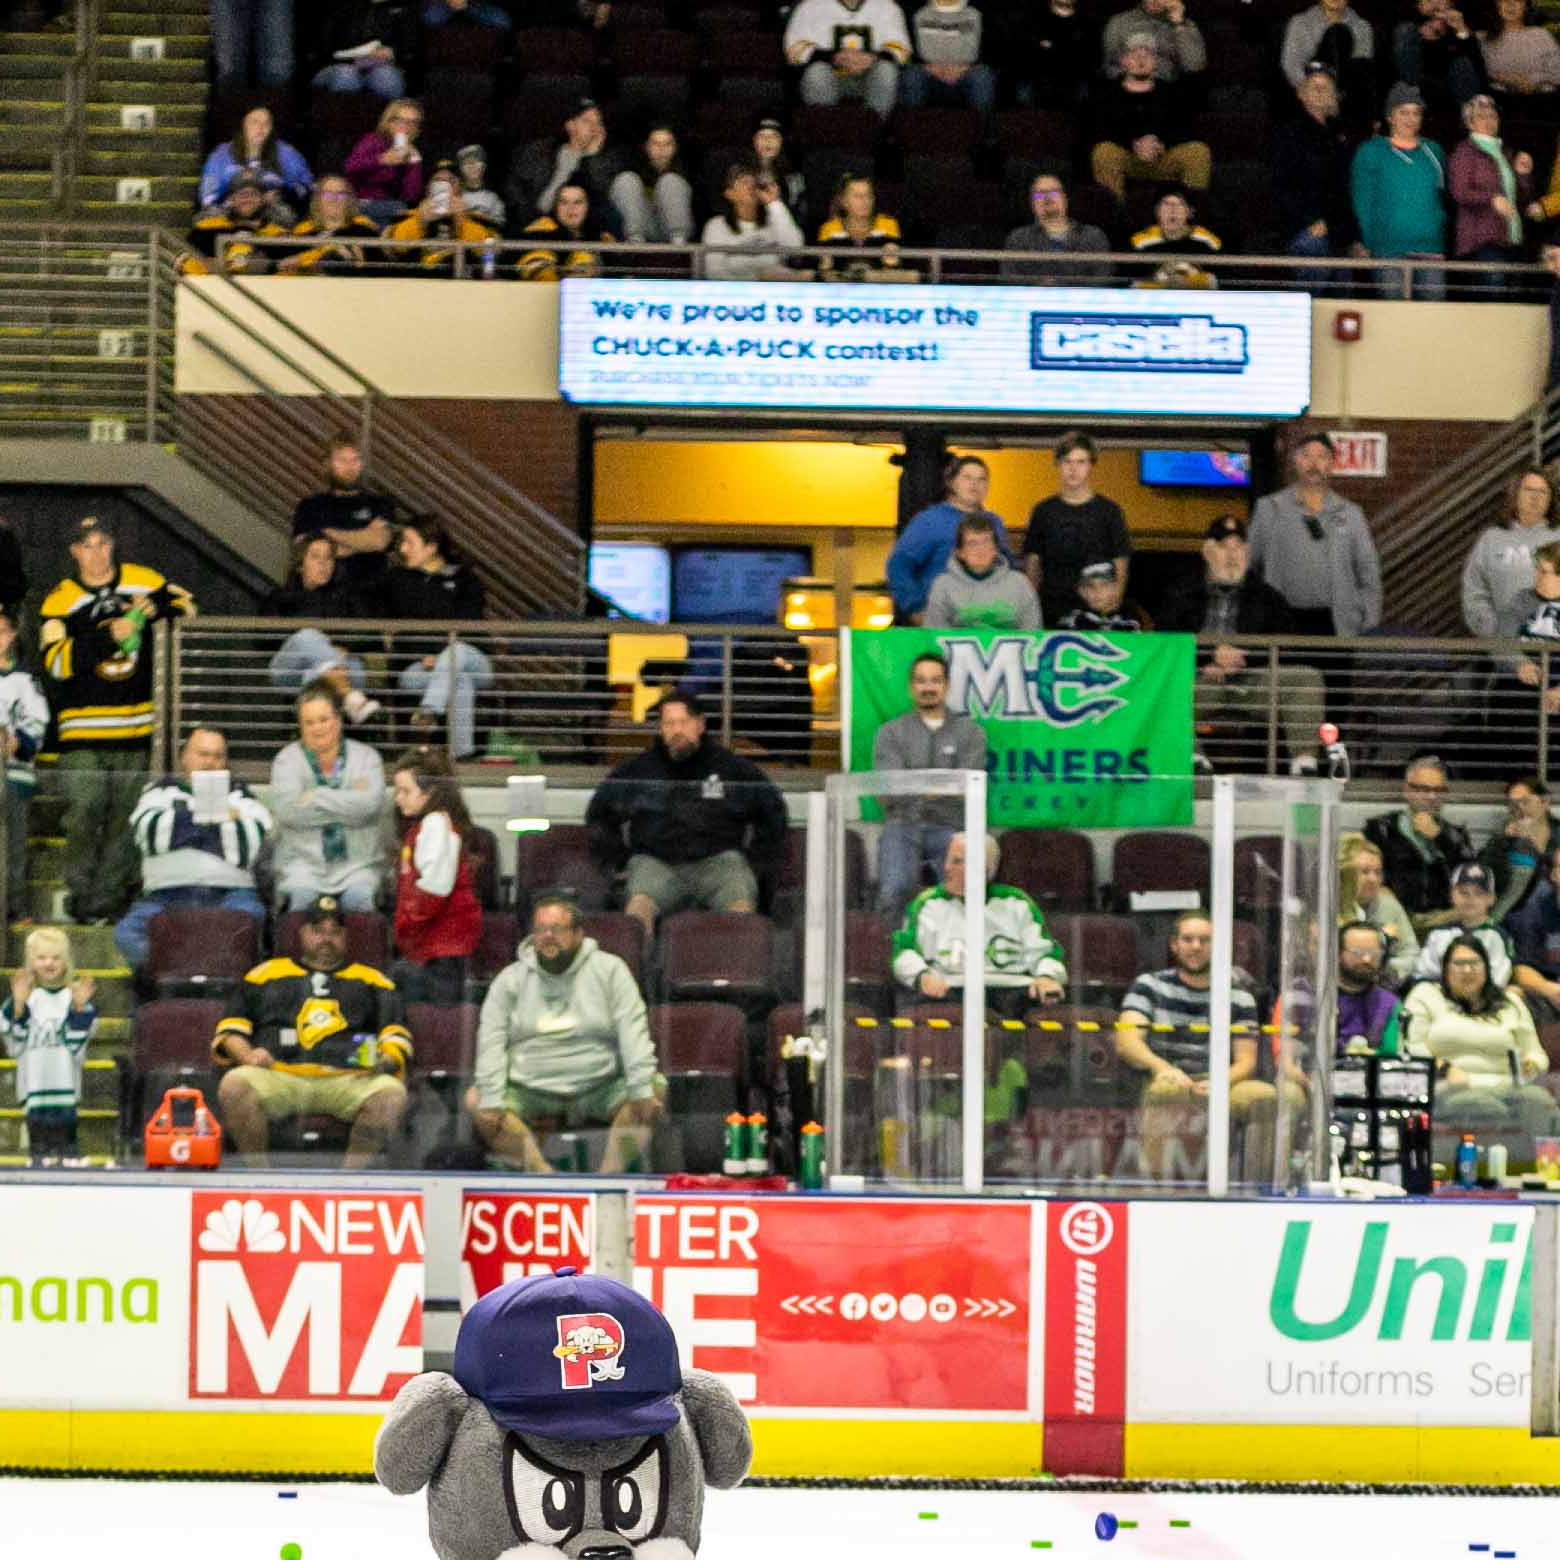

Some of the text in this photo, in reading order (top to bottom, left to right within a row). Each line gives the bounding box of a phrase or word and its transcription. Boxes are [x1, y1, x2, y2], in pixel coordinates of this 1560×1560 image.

[592, 300, 978, 327] We're proud to sponsor the
[825, 341, 939, 362] contest!
[1333, 438, 1377, 468] EXIT
[986, 747, 1151, 786] RINERS
[170, 1142, 191, 1163] G
[556, 1312, 625, 1389] P
[1072, 1259, 1098, 1417] WARRIOR
[1265, 1360, 1434, 1397] Uniforms
